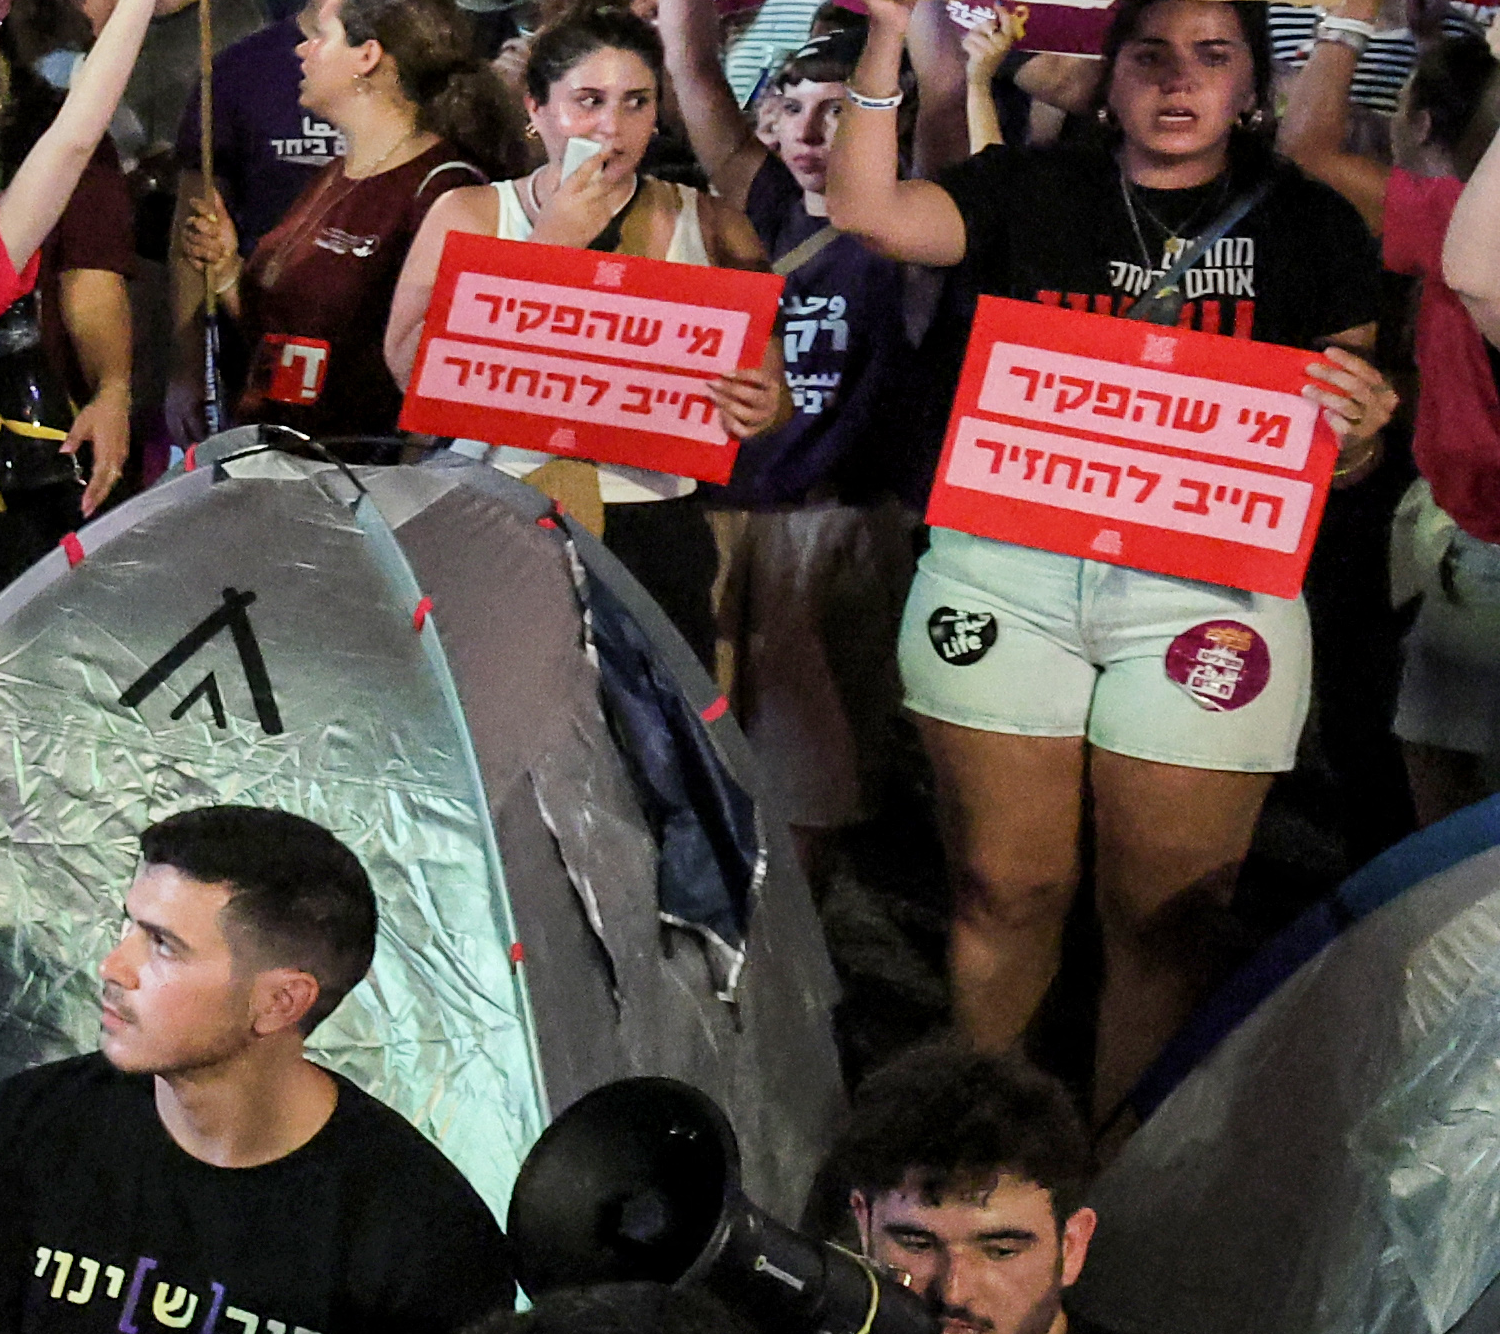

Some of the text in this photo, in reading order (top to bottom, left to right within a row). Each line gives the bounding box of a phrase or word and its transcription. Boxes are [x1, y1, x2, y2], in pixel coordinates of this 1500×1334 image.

[271, 138, 328, 155] ביחד
[1185, 268, 1256, 299] אותם
[474, 292, 724, 358] מי שהפקיר
[784, 319, 849, 363] רק
[444, 355, 716, 425] חייב להחזיר
[1009, 366, 1292, 449] מי שהפקיר
[975, 438, 1284, 529] חייב להחזיר
[941, 633, 983, 659] Life
